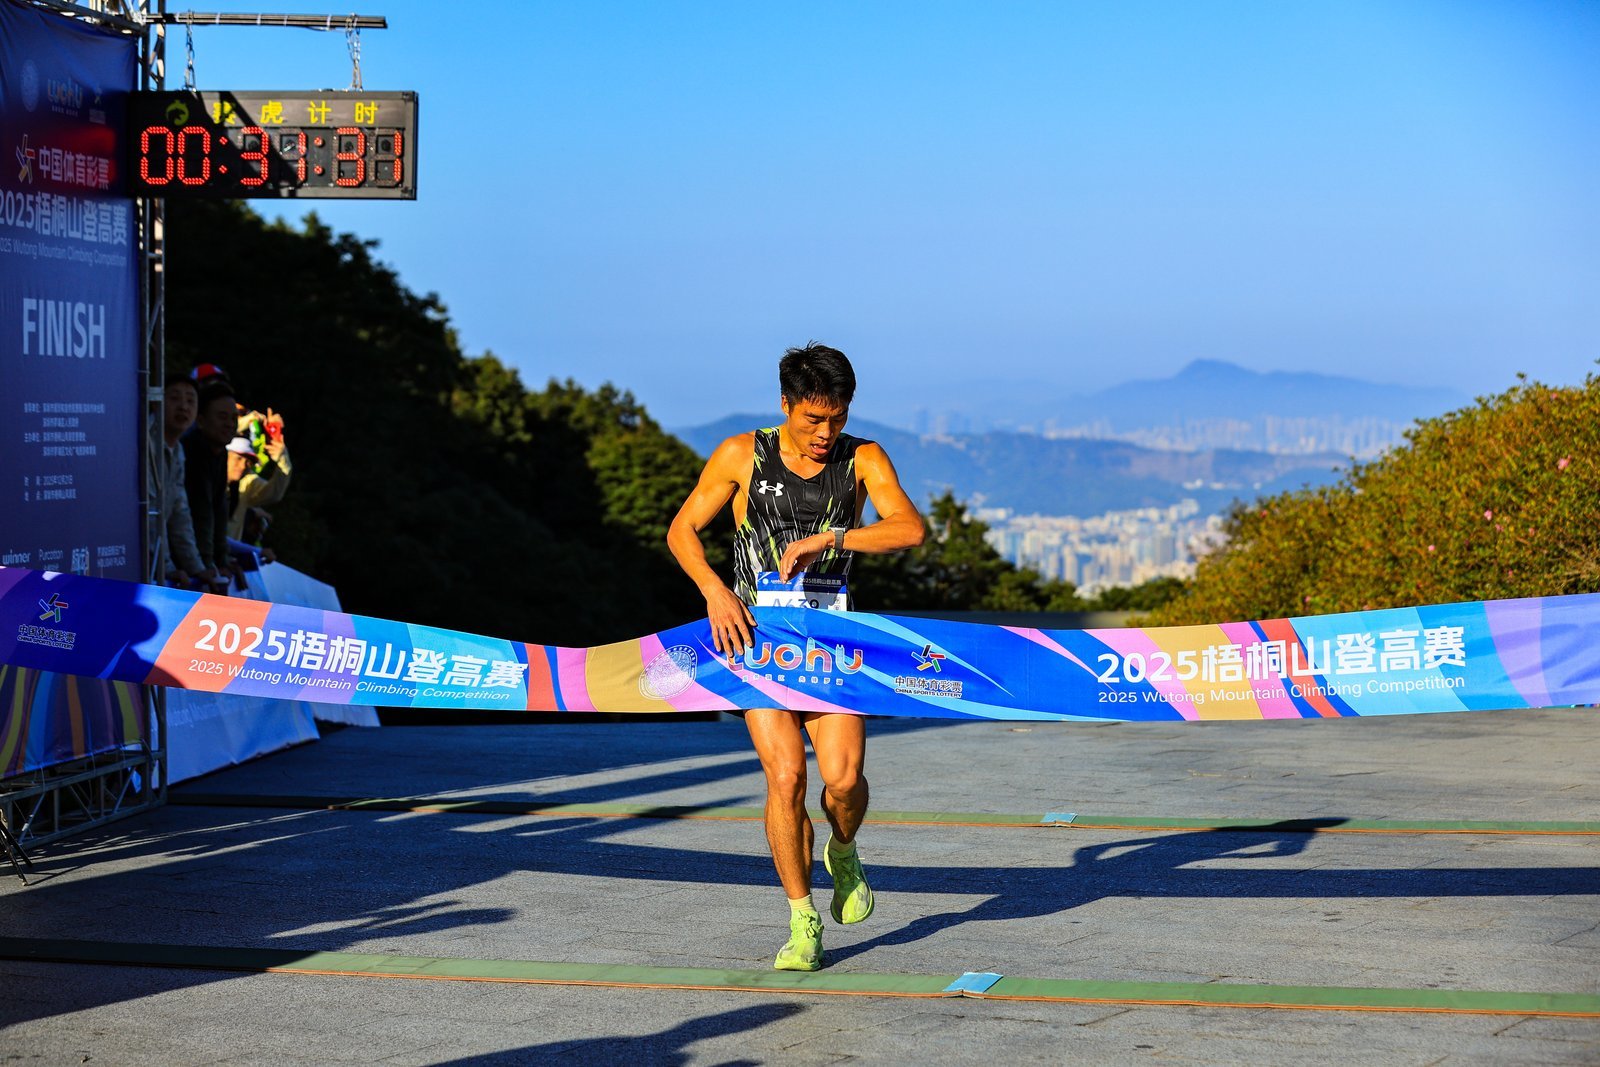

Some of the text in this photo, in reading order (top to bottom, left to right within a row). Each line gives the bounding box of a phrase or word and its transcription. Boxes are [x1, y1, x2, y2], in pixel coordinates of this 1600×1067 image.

[39, 145, 109, 190] 中国体育彩票
[141, 126, 403, 187] 00:31:31
[22, 297, 106, 359] FINISH
[2, 549, 31, 565] winner
[18, 624, 76, 643] 中国体育彩票
[194, 619, 529, 689] 2025梧桐山登高赛
[1097, 625, 1466, 684] 2025梧桐山登高赛
[188, 659, 511, 701] 2025 Wutong Mountain Climbing Competition
[895, 676, 962, 692] 中国体育彩票
[1098, 675, 1465, 705] 2025 Wutong Mountain Climbing Competition
